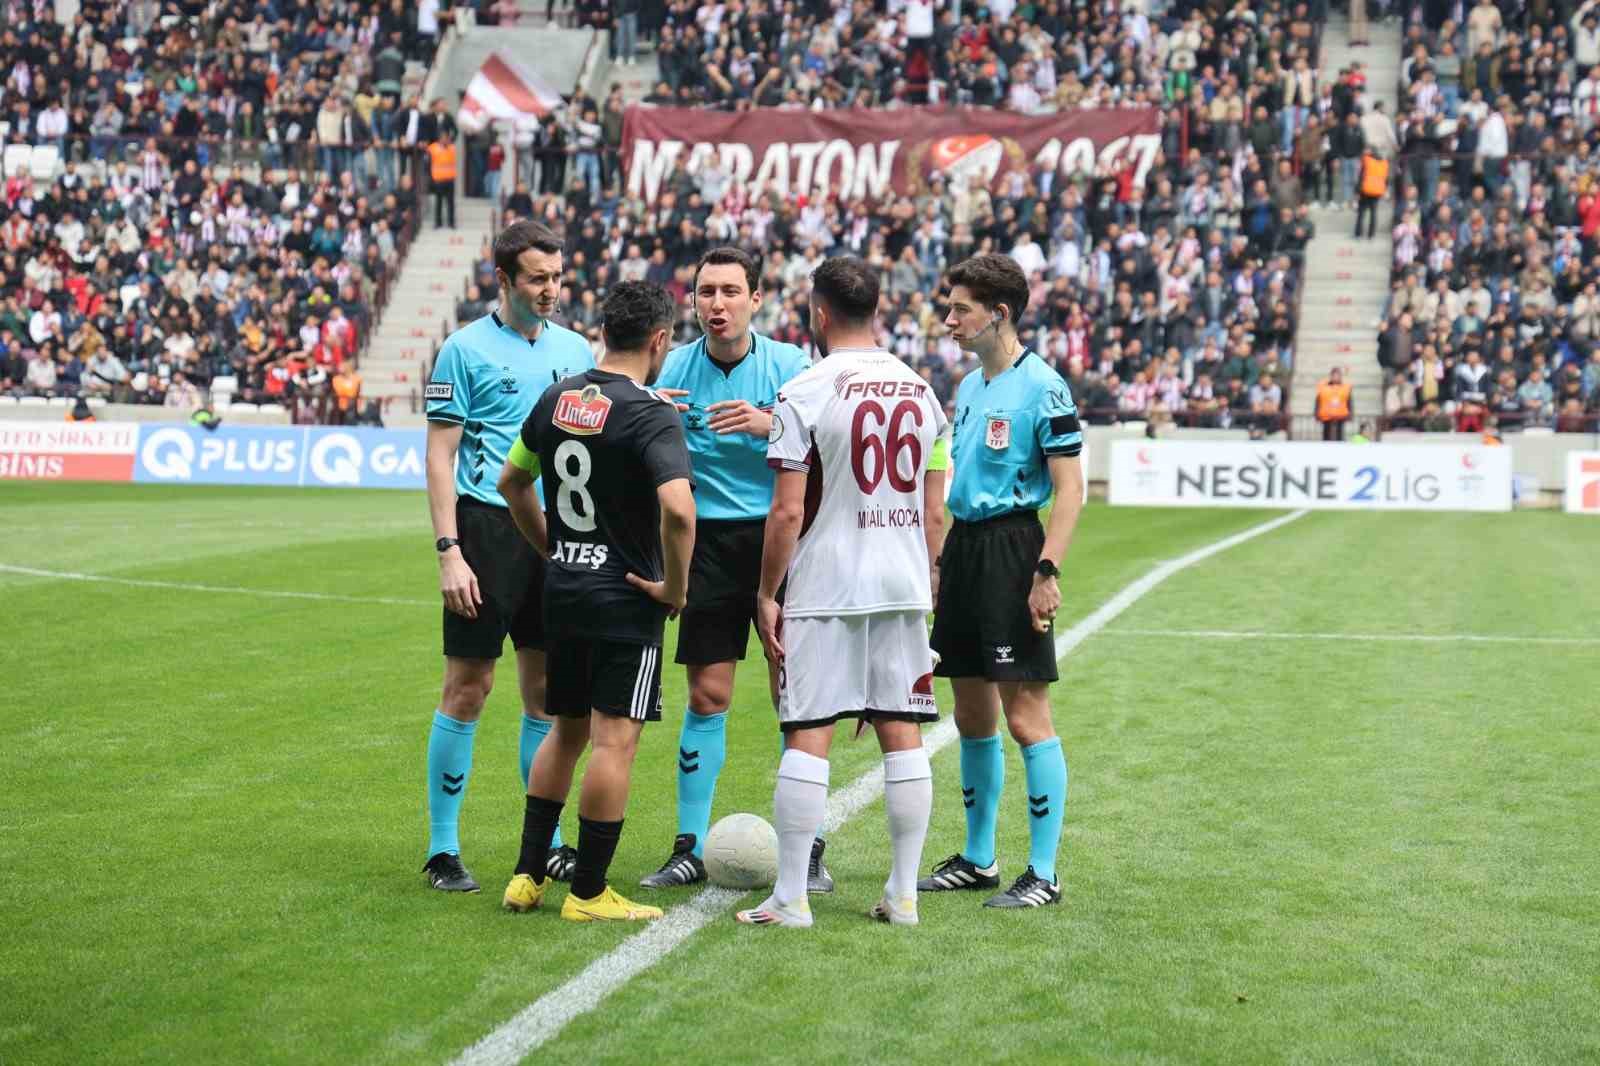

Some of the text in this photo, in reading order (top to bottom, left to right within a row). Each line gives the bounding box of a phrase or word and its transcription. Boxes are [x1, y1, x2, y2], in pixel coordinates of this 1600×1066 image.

[844, 381, 927, 400] PROEM
[200, 439, 296, 472] PLUS
[851, 400, 923, 495] 66
[553, 439, 598, 532] 8
[1175, 452, 1339, 500] NESİNE
[551, 540, 609, 570] ATEŞ
